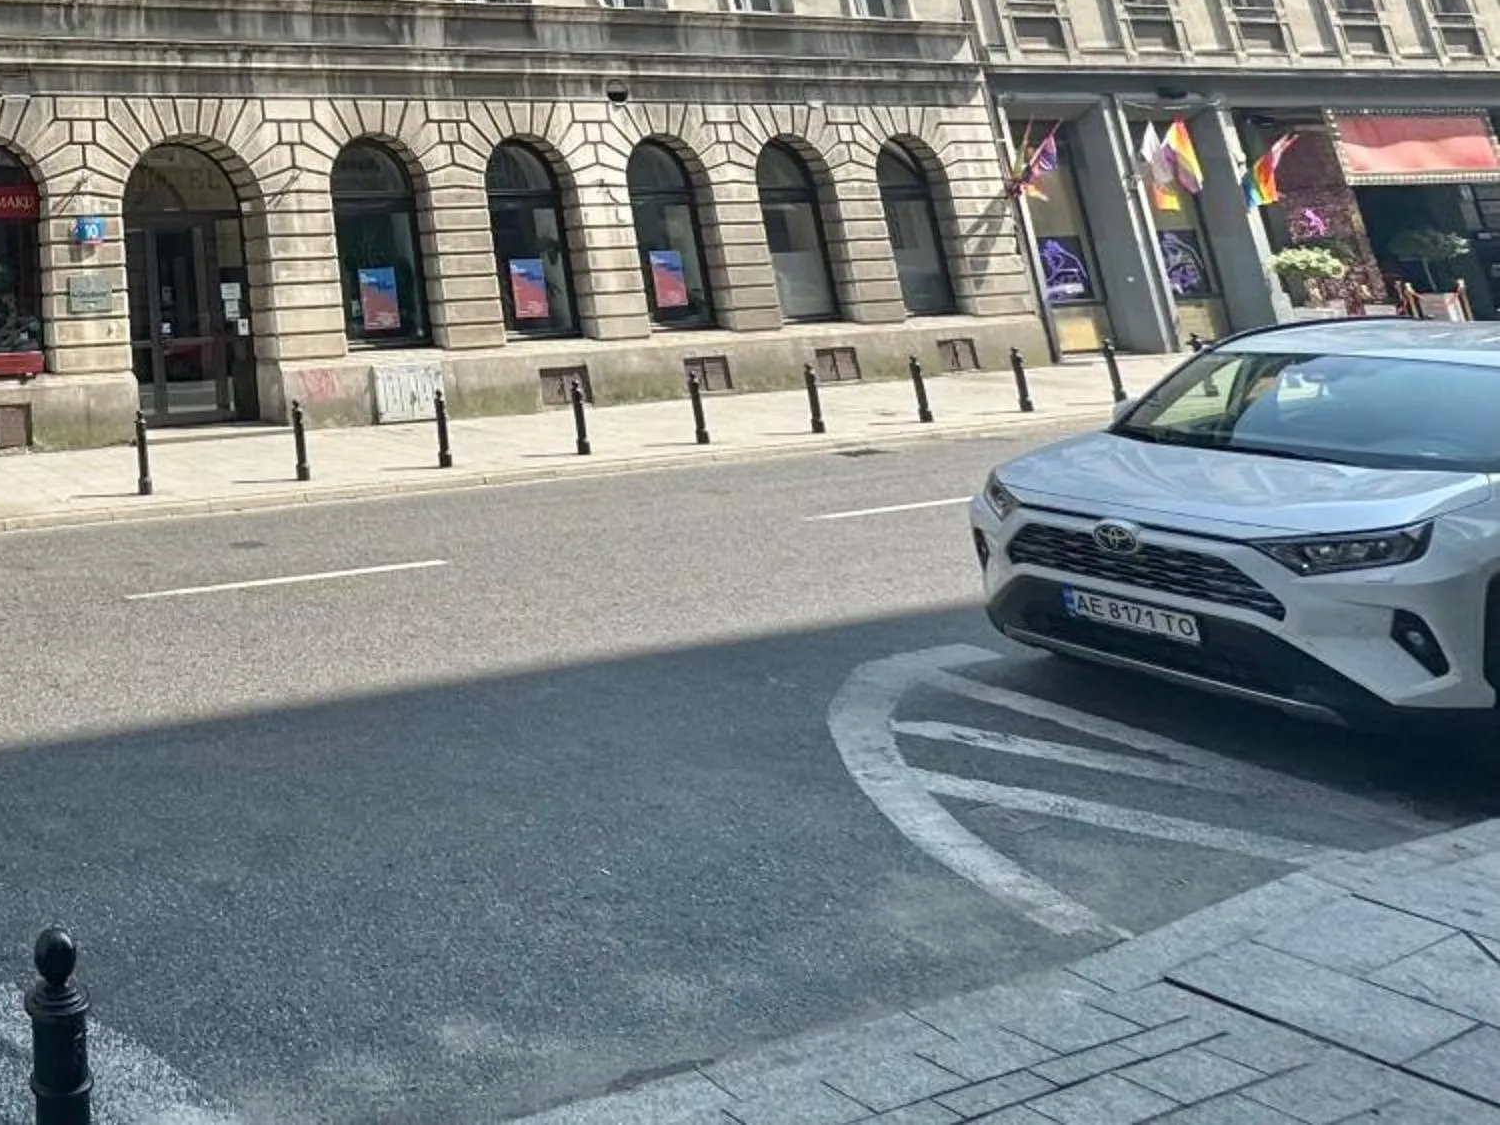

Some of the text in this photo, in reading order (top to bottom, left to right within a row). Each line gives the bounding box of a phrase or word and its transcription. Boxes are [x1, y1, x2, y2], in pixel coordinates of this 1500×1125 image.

[1076, 594, 1103, 616] AE
[1108, 602, 1157, 629] 8171
[1161, 613, 1195, 636] TO
